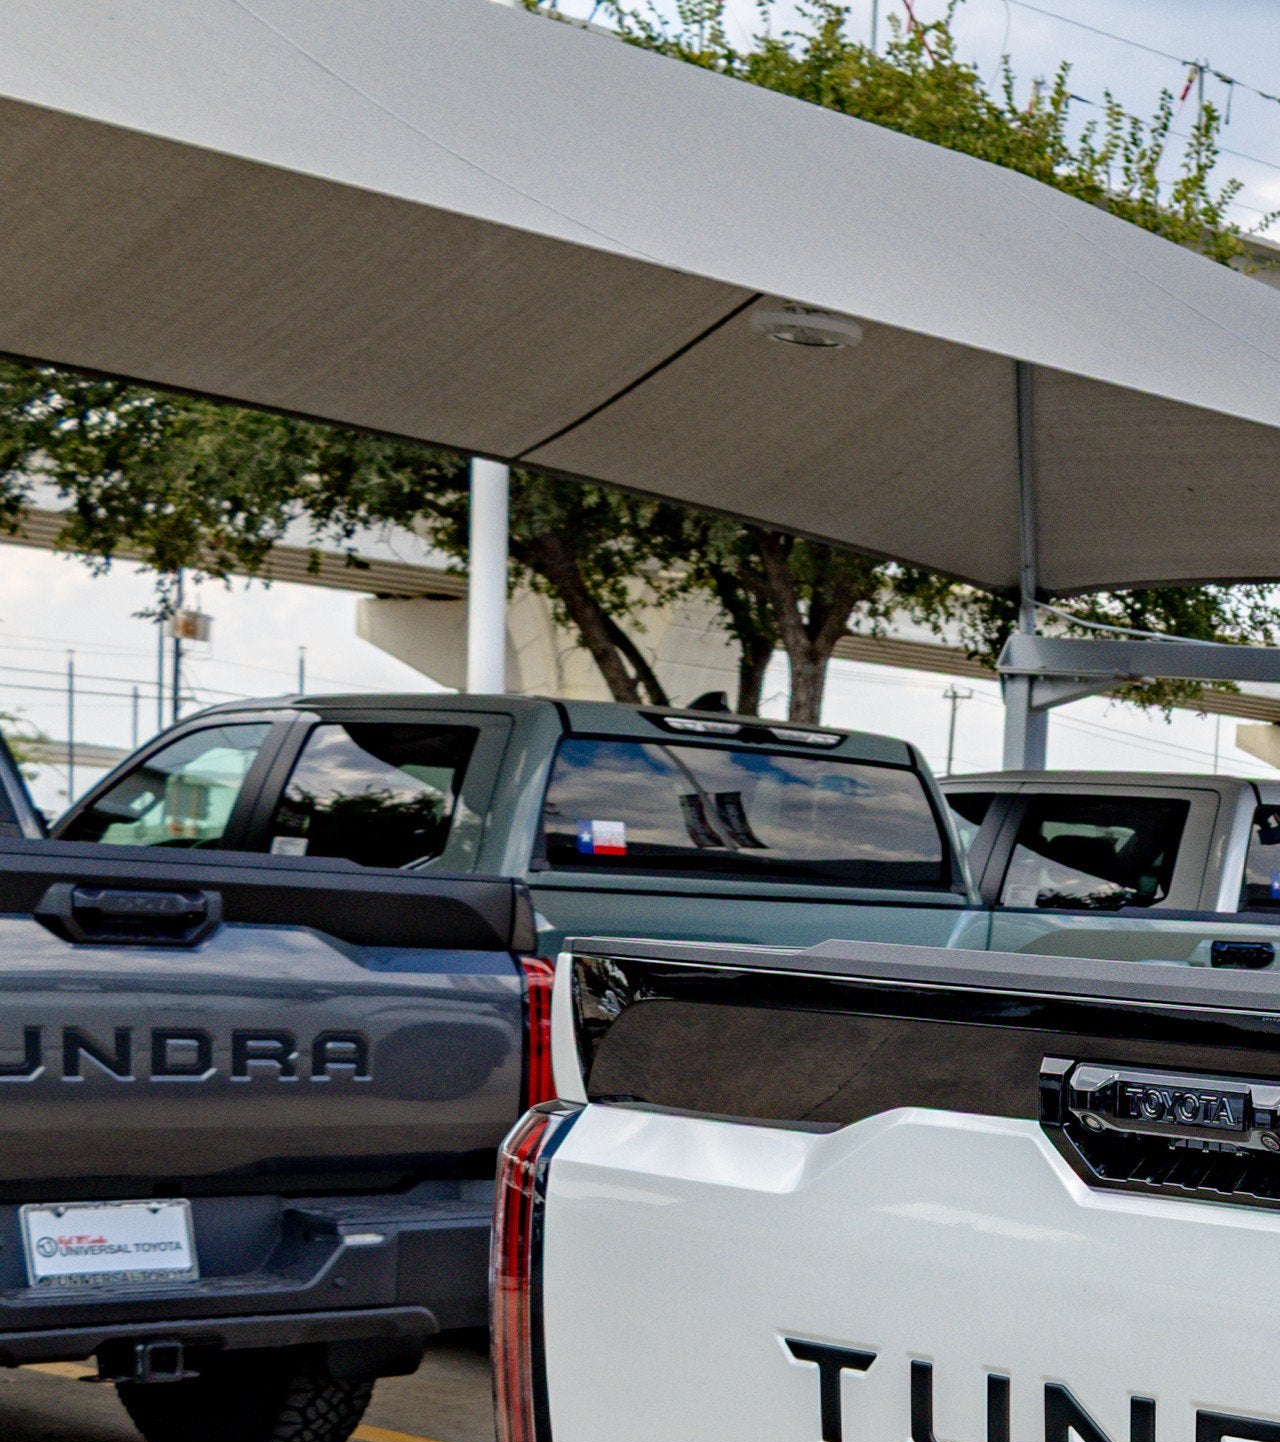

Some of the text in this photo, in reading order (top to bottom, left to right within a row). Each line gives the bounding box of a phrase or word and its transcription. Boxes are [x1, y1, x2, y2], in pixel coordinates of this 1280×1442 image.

[1126, 1088, 1235, 1125] TOYOTA
[60, 1241, 183, 1257] UNIVERSAL TOYOTA
